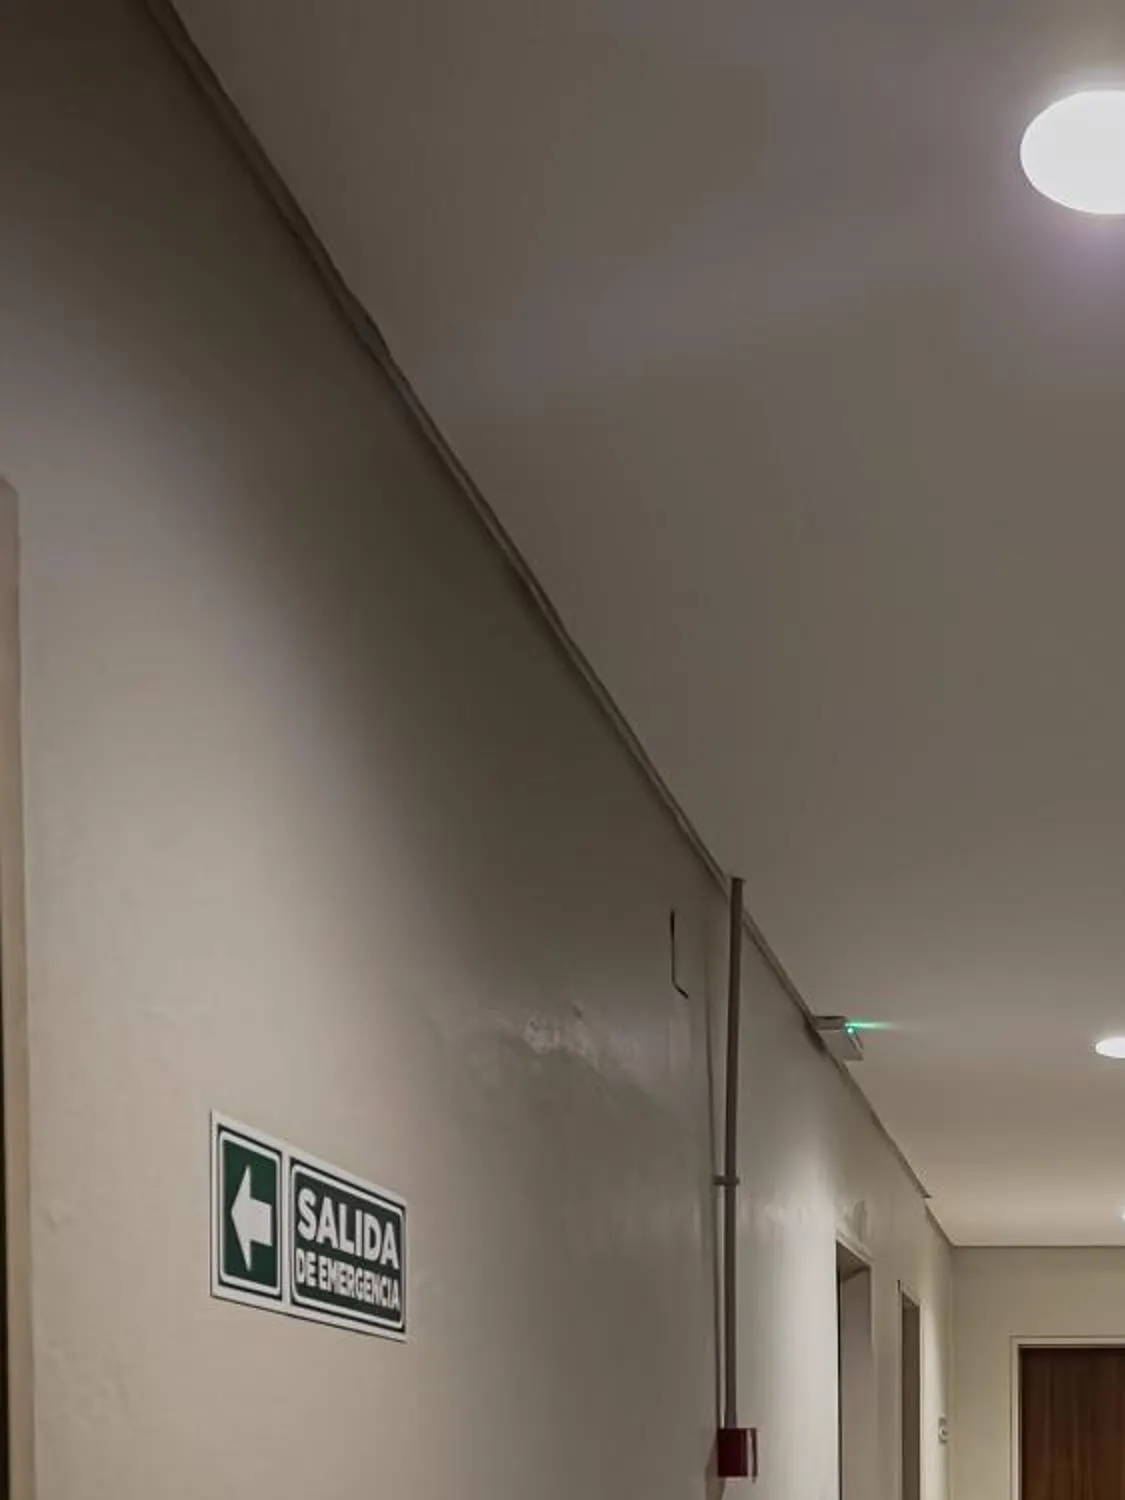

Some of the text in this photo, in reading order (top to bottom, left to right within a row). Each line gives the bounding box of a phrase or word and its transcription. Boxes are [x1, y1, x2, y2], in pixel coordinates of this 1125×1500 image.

[298, 1188, 399, 1269] SALIDA
[296, 1249, 400, 1309] DE EMERGENCIA
